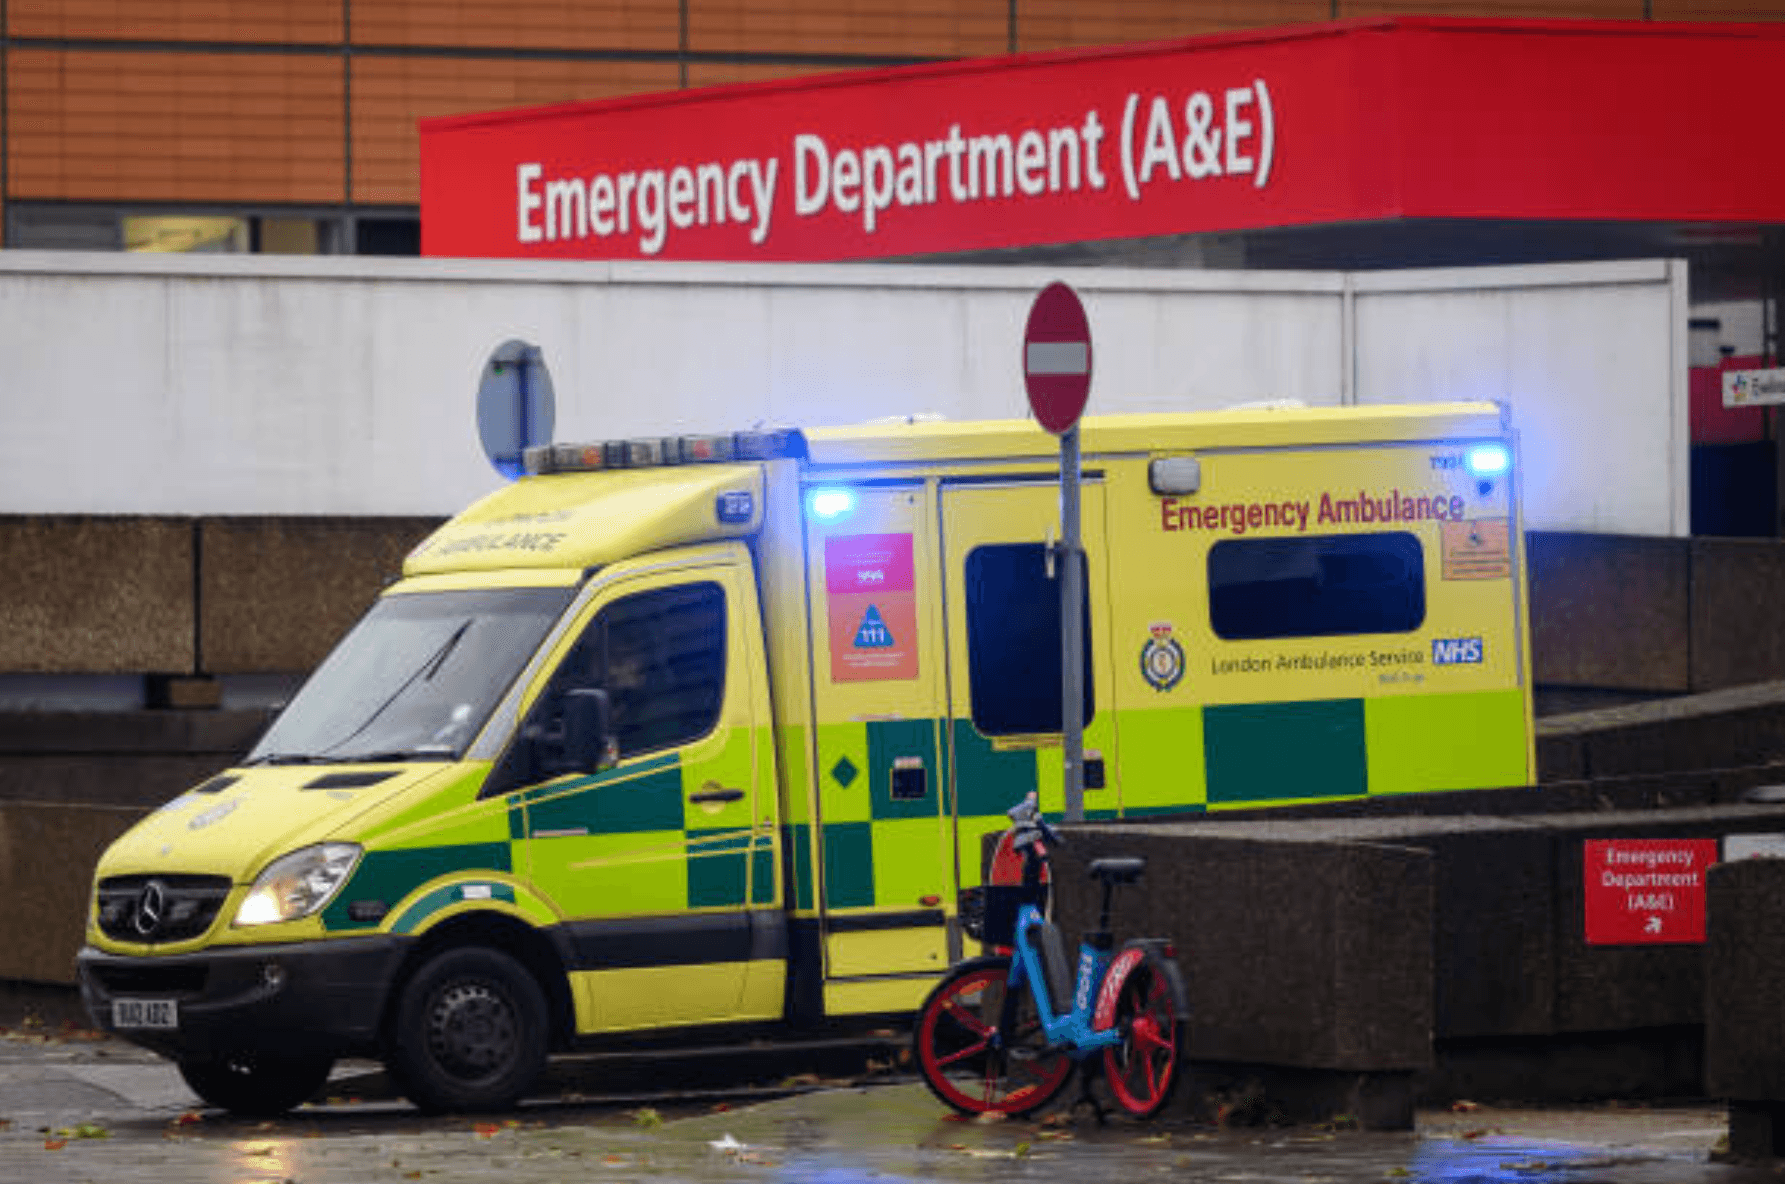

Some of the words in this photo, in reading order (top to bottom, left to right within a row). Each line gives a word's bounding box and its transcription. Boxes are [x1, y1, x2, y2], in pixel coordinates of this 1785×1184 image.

[517, 157, 778, 252] Emergency
[794, 110, 1105, 232] Department
[1120, 79, 1274, 200] (A&E)
[1161, 496, 1310, 534] Emergency
[1317, 488, 1465, 525] Ambulance
[862, 627, 885, 643] 111
[1211, 654, 1272, 675] London
[1275, 649, 1366, 672] Ambulance
[1369, 647, 1425, 666] Service
[1433, 639, 1482, 664] NHS
[1606, 848, 1694, 868] Emergency
[1602, 871, 1699, 892] Department
